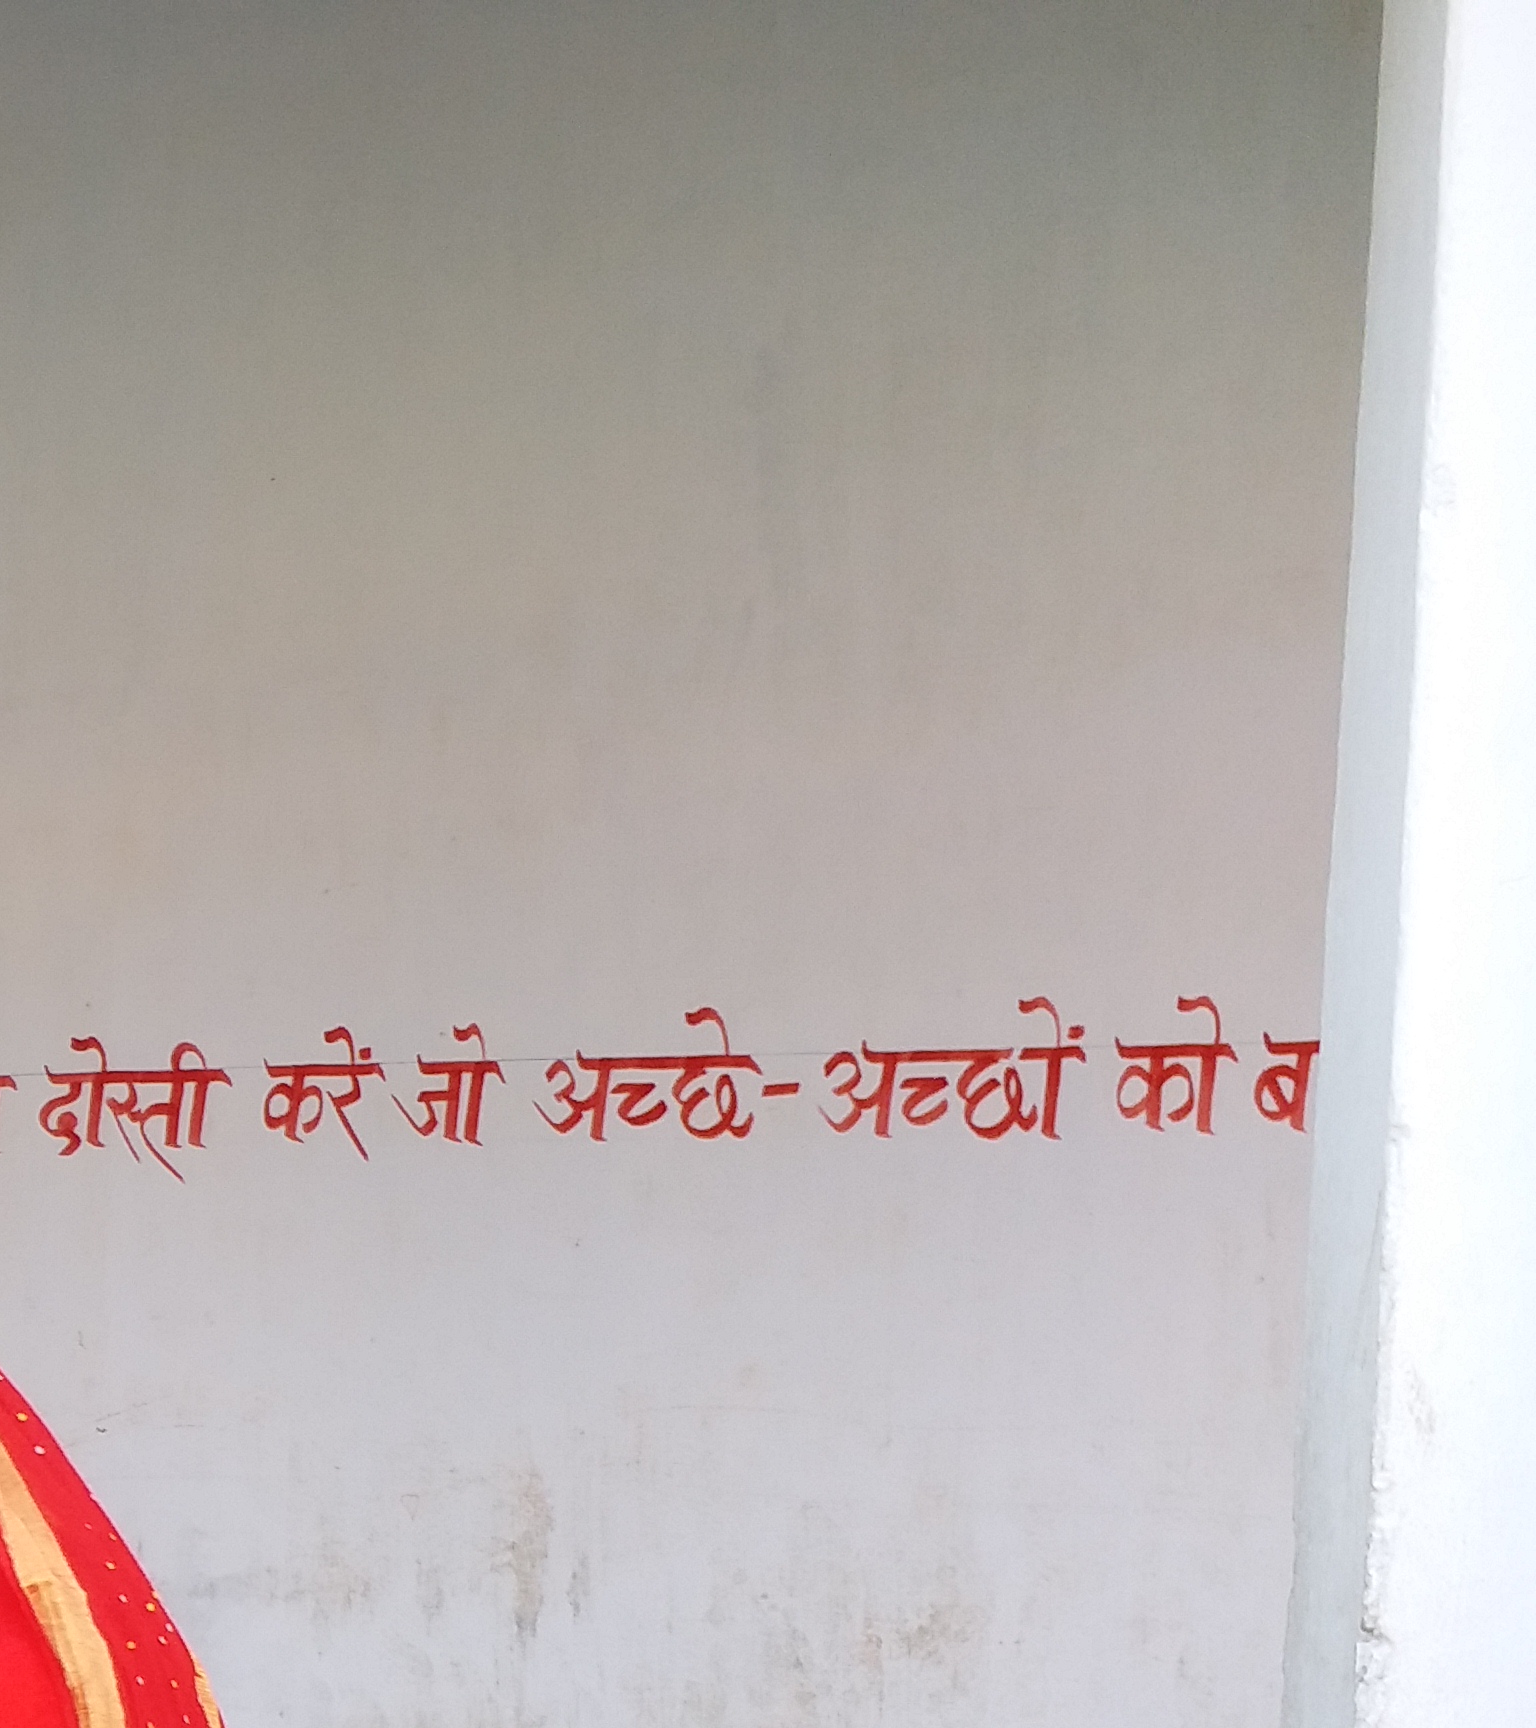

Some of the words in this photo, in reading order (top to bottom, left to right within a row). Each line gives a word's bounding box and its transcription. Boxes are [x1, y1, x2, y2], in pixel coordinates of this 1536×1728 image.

[40, 1038, 233, 1180] दोस्ती
[265, 1028, 386, 1158] करें
[411, 1025, 503, 1147] जो
[1116, 997, 1238, 1136] को
